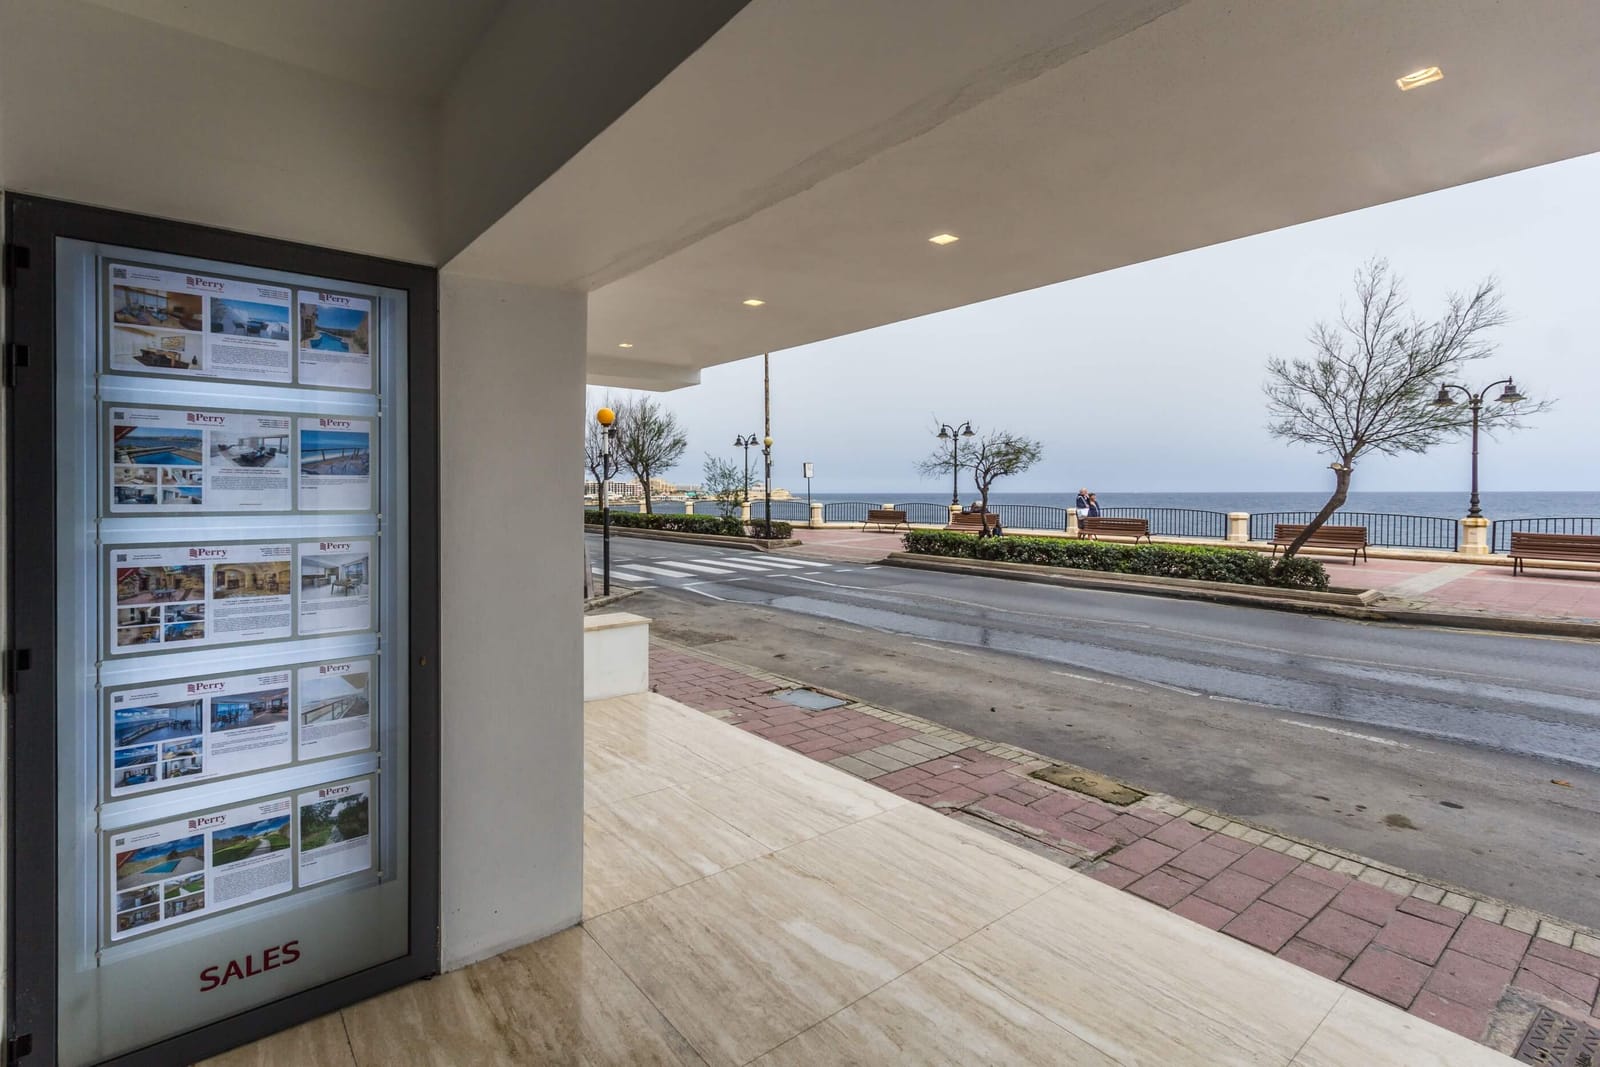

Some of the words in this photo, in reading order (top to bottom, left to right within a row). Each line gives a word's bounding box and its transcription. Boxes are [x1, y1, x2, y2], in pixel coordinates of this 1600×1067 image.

[195, 277, 225, 290] Perry
[326, 294, 351, 305] Perry
[195, 413, 225, 425] Perry
[327, 418, 351, 428] Perry
[326, 542, 351, 552] Perry
[198, 548, 227, 557] Perry
[327, 663, 351, 672] Perry
[196, 681, 225, 691] Perry
[326, 785, 351, 795] Perry
[197, 814, 226, 826] Perry
[200, 940, 301, 991] SALES
